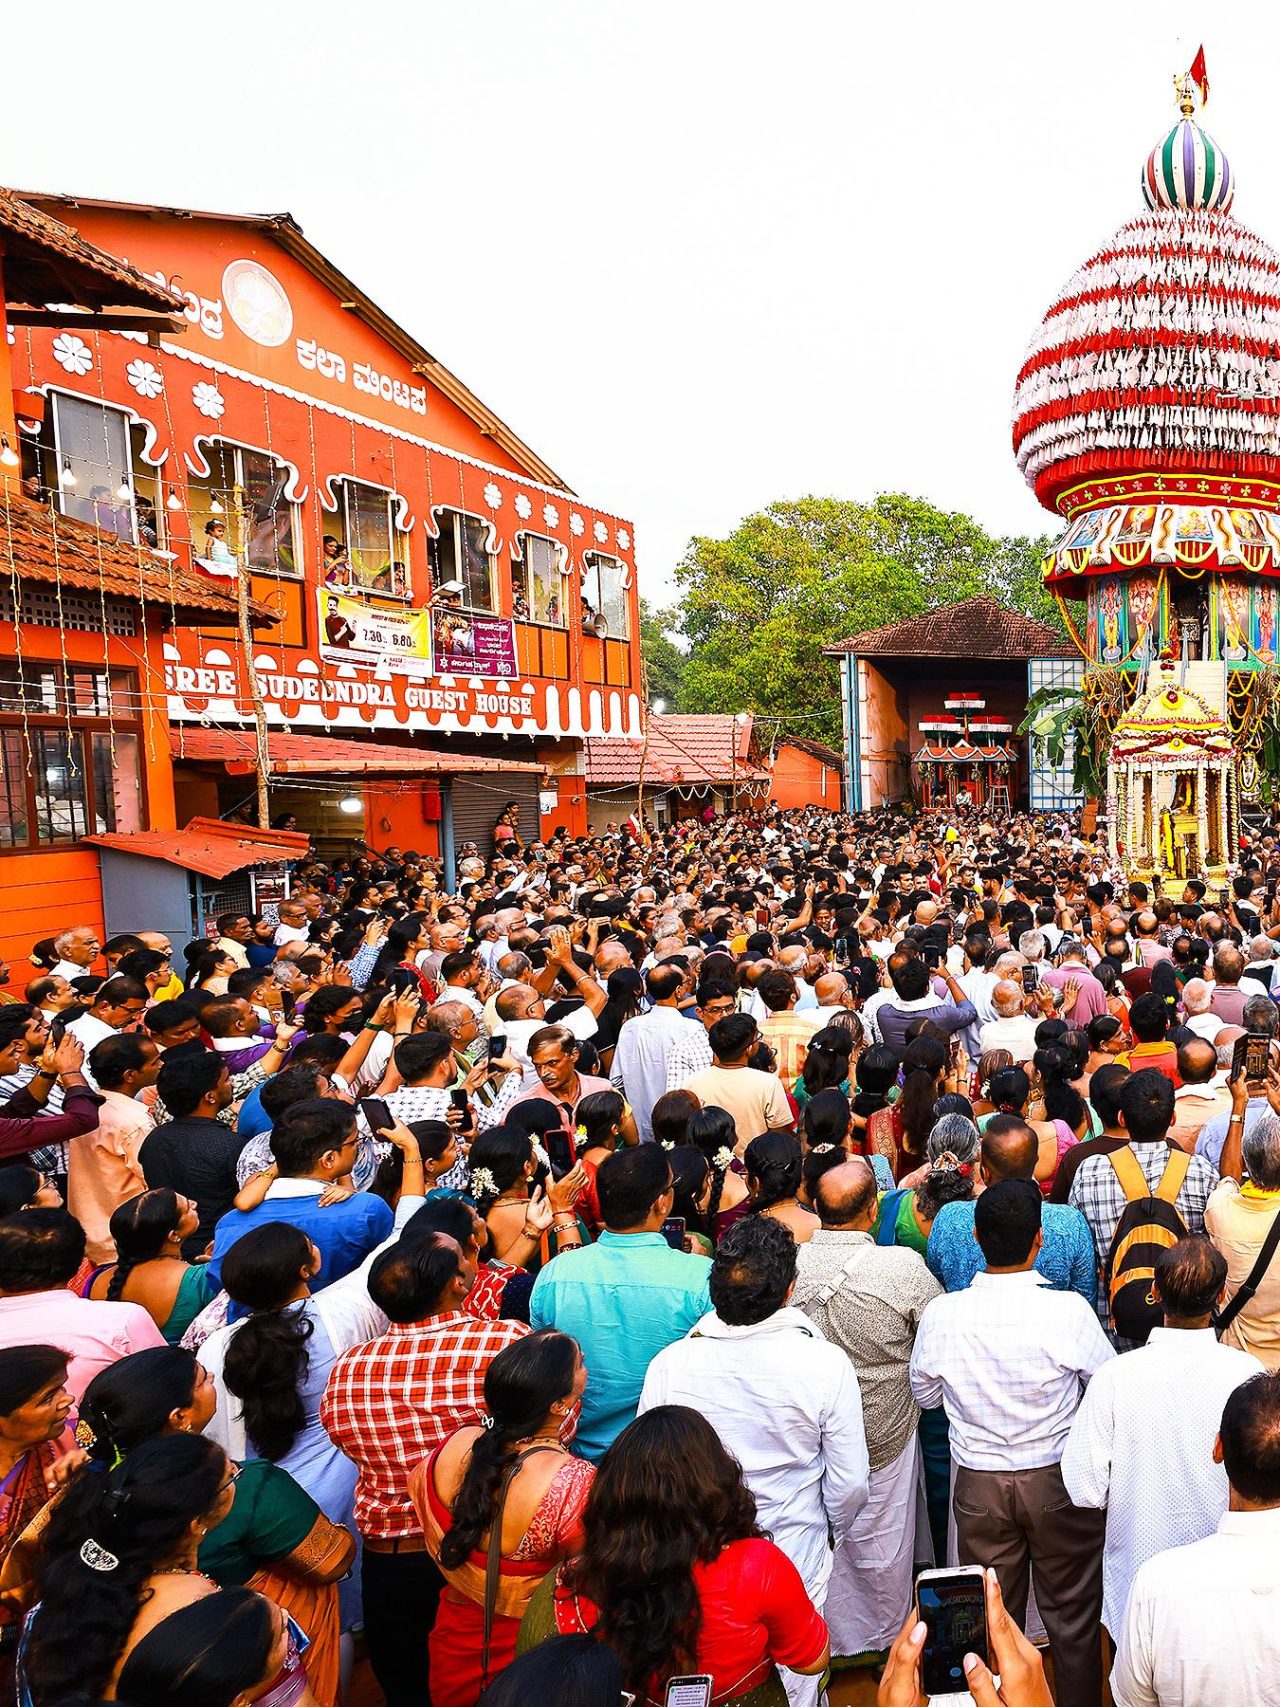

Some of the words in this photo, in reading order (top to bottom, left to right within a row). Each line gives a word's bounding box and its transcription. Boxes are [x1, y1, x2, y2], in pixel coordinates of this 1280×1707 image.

[296, 338, 346, 384] ಕಲಾ
[353, 362, 427, 416] ಮಂಟಪ
[404, 687, 468, 712] GUEST
[476, 692, 533, 716] HOUSE
